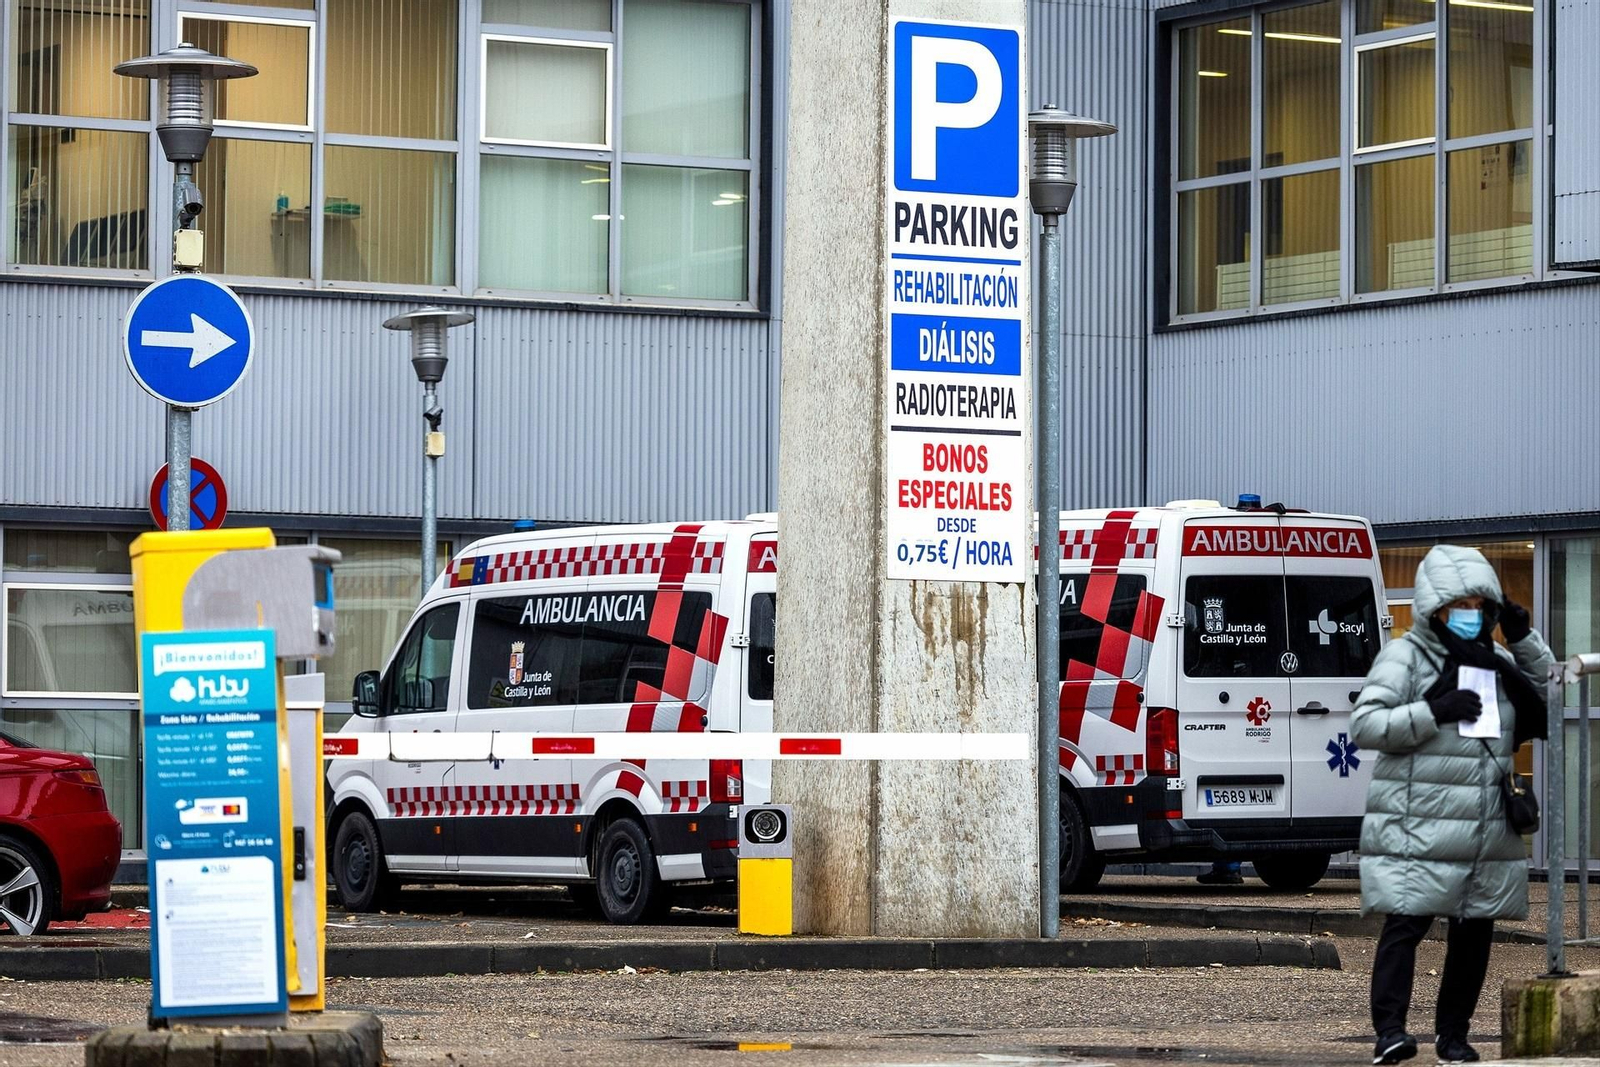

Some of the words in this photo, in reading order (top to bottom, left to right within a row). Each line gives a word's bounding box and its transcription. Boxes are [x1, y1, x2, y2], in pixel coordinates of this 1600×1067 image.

[910, 35, 1003, 181] P
[894, 201, 1019, 250] PARKING
[893, 268, 1018, 308] REHABILITACIÓN
[918, 321, 996, 365] DIÁLISIS
[896, 382, 1017, 419] RADIOTERAPIA
[922, 443, 988, 474] BONOS
[898, 479, 1012, 511] ESPECIALES
[937, 517, 976, 533] DESDE
[897, 539, 949, 566] 0,75€
[952, 536, 961, 569] /
[966, 540, 1013, 566] HORA
[1190, 529, 1363, 554] AMBULANCIA
[520, 595, 646, 624] AMBULANCIA
[1200, 633, 1234, 644] Castilla
[1235, 635, 1242, 646] y
[1243, 633, 1267, 644] León
[1225, 622, 1253, 633] Junta
[1254, 622, 1266, 633] de
[1339, 622, 1365, 636] Sacyl
[522, 671, 542, 683] Junta
[543, 670, 552, 681] de
[504, 685, 528, 698] Castilla
[527, 686, 534, 699] y
[534, 684, 552, 696] León
[1213, 789, 1246, 804] 5689
[1249, 789, 1273, 803] MJM
